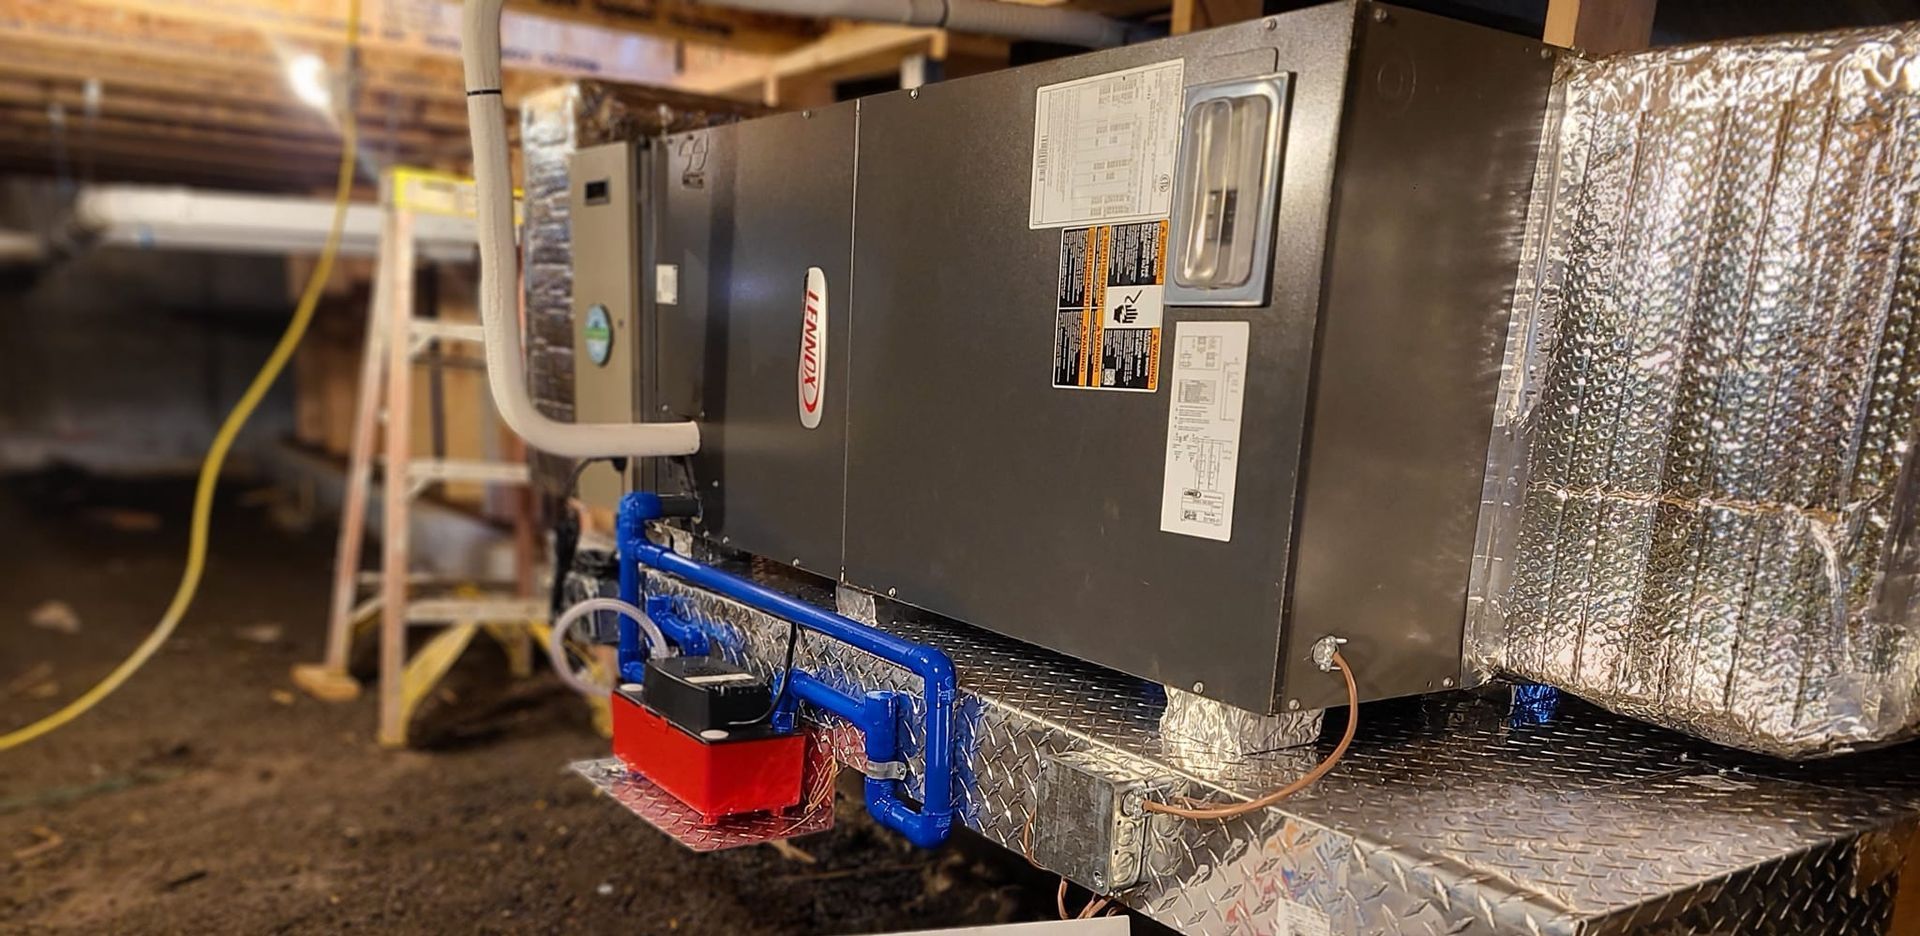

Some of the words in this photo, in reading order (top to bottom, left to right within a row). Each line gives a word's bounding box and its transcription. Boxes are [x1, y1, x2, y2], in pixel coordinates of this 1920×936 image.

[804, 290, 819, 389] LENNOX
[1080, 336, 1088, 373] WARNING
[1094, 336, 1102, 373] WARNING
[1150, 343, 1158, 384] WARNING
